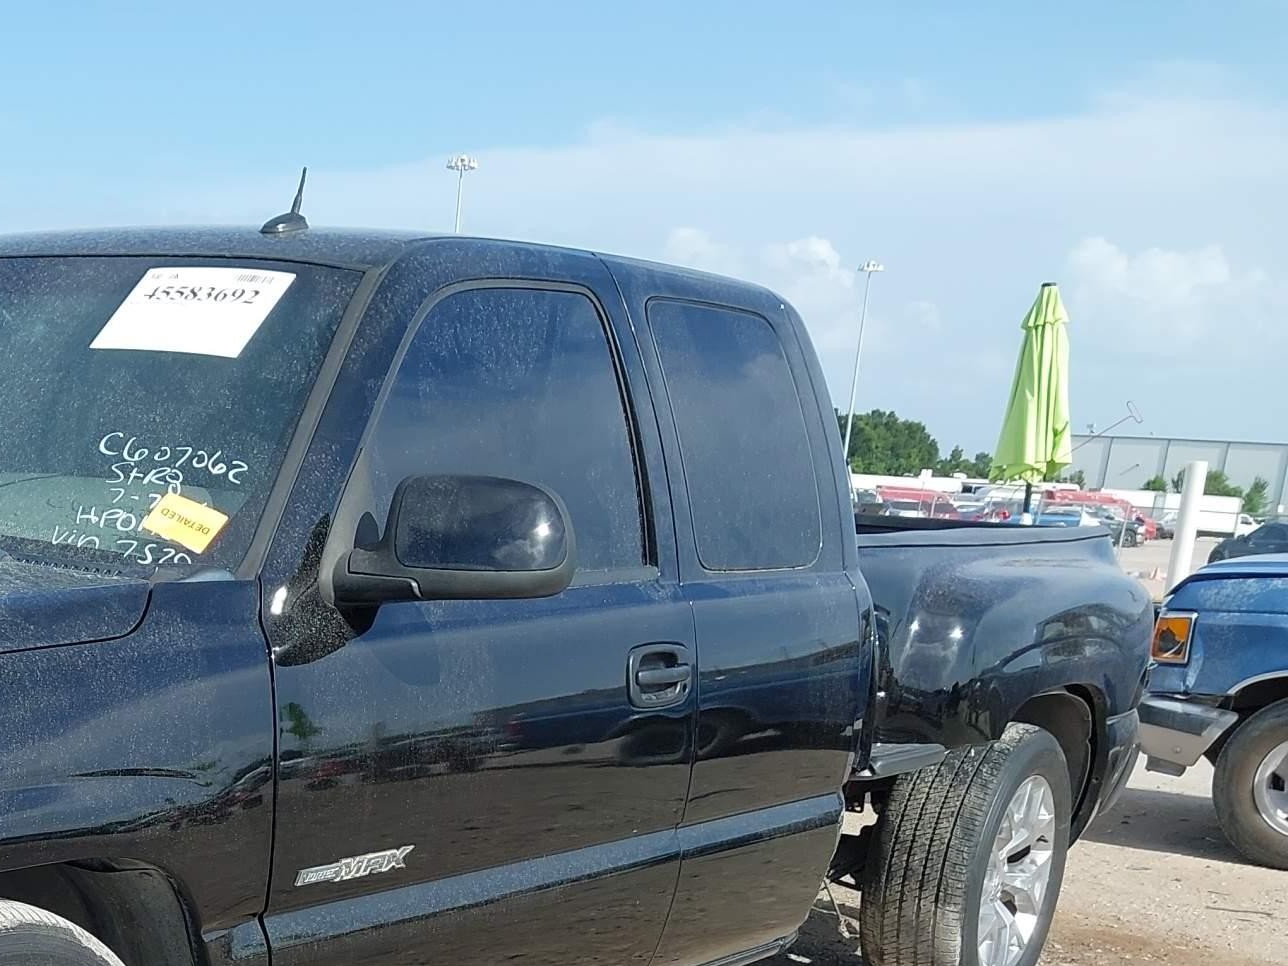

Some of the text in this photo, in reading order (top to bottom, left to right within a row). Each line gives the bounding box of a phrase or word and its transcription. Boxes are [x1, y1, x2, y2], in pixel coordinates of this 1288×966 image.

[144, 286, 260, 304] 45583692
[98, 432, 249, 485] C607062
[160, 507, 211, 536] DETAILED
